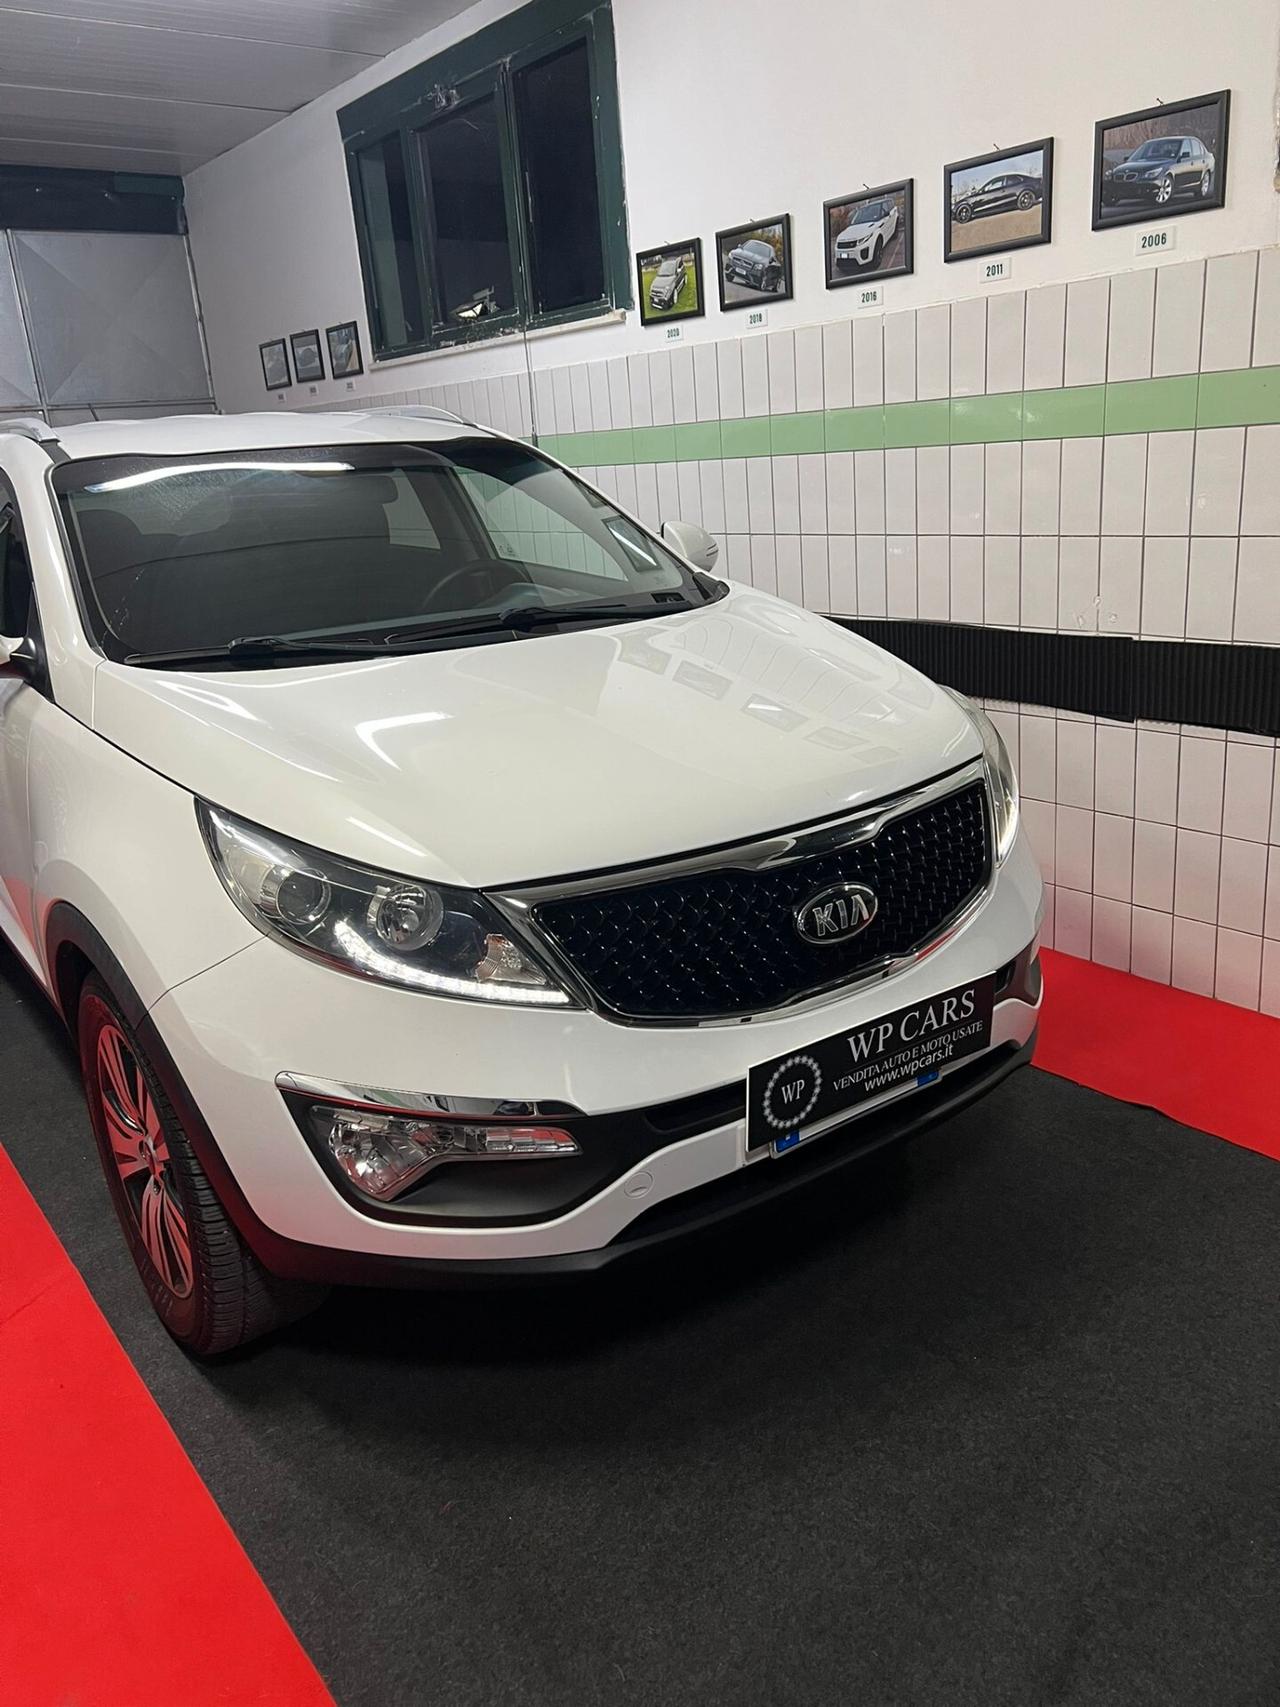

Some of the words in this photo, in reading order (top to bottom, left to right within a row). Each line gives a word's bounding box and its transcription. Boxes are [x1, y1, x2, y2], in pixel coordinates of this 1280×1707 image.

[1141, 233, 1167, 248] 2006
[986, 264, 1003, 277] 2011
[861, 291, 877, 303] 2016
[749, 313, 763, 324] 2018
[812, 894, 870, 936] KIA
[847, 1022, 894, 1063] WP
[899, 989, 976, 1042] CARS
[833, 1063, 881, 1092] VENDITA
[881, 1051, 911, 1071] AUTO
[912, 1048, 919, 1059] E
[919, 1035, 950, 1056] MOTO
[951, 1020, 984, 1043] USATE
[864, 1043, 954, 1092] www.wpcars.it
[781, 1079, 805, 1105] WP
